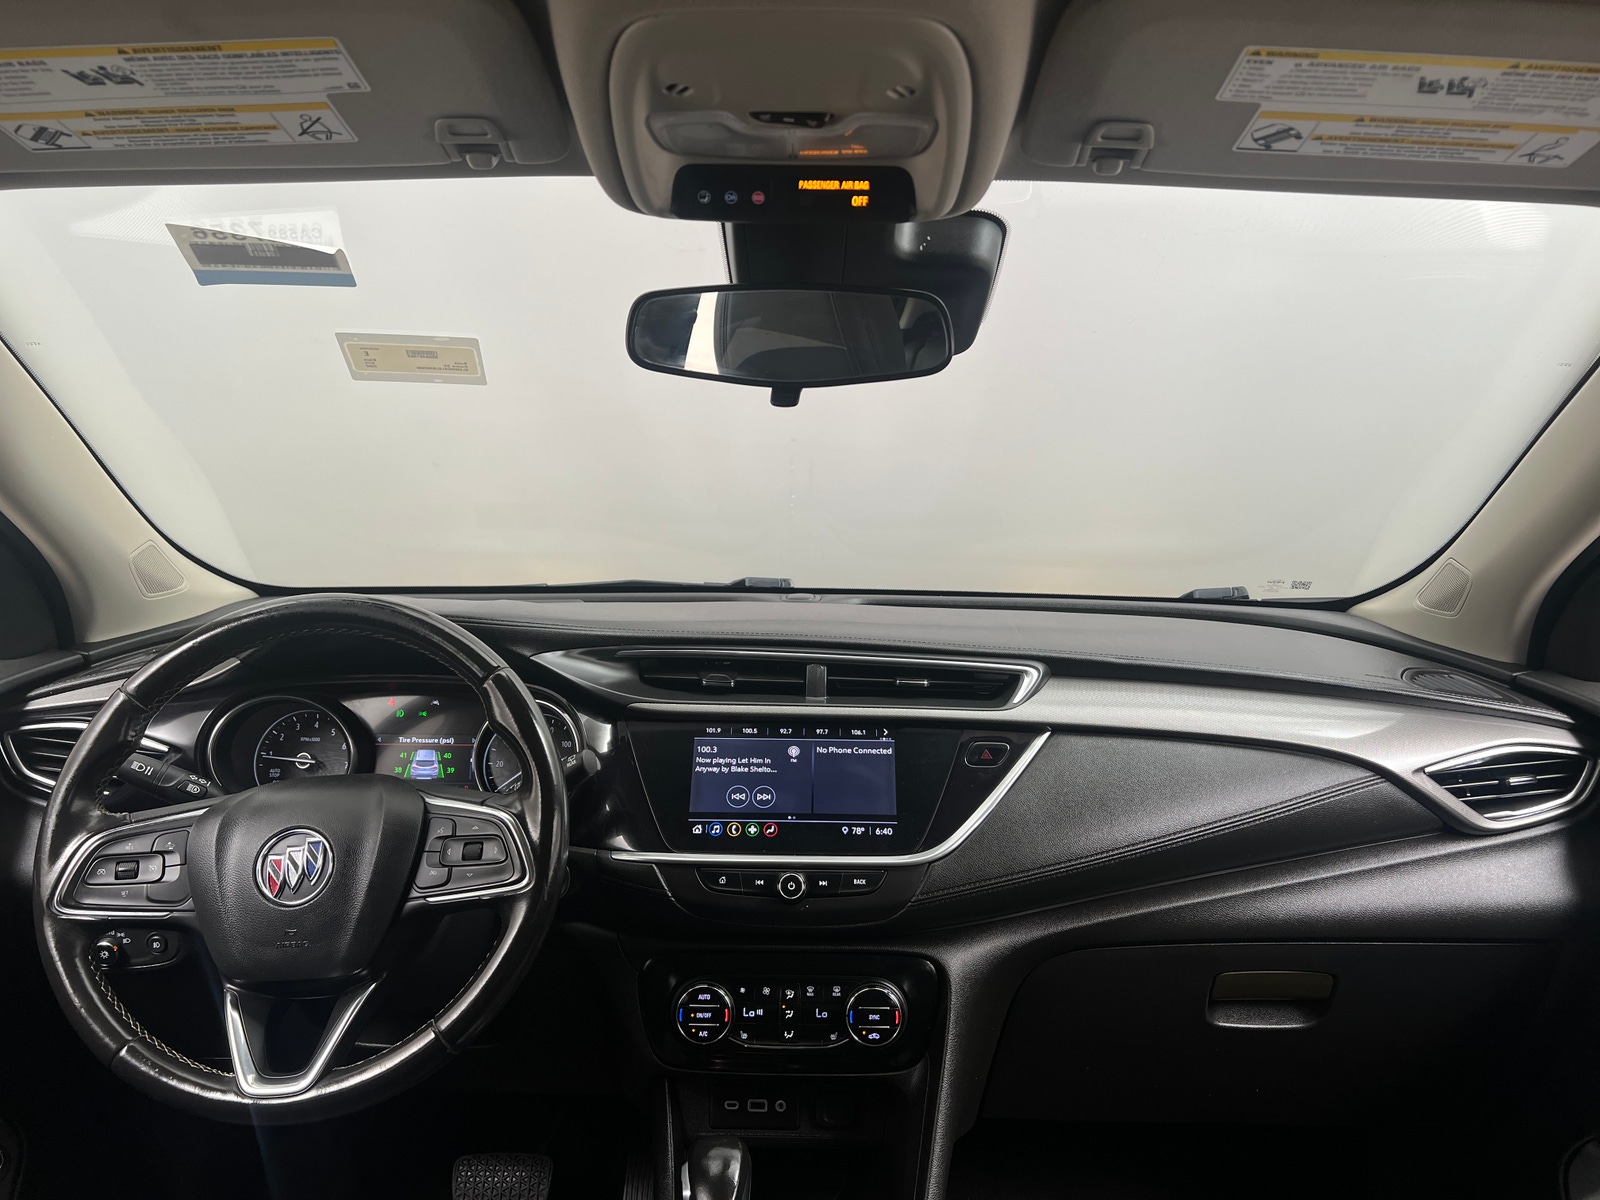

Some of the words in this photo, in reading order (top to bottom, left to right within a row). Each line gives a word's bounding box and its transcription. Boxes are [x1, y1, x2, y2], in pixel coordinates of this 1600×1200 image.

[798, 180, 840, 190] PASSENGER
[840, 180, 854, 190] AIR
[854, 180, 870, 190] BAG
[851, 195, 869, 207] OFF
[440, 737, 455, 745] (psi)
[561, 740, 572, 748] 100
[853, 747, 892, 755] Connected
[344, 761, 348, 769] 7
[495, 760, 504, 768] 20
[712, 757, 737, 766] playing
[394, 766, 403, 774] 38
[446, 766, 455, 774] 39
[695, 766, 720, 774] Anyway
[721, 766, 729, 774] by
[851, 826, 865, 835] 78°
[875, 827, 893, 836] 6:40
[697, 993, 711, 1001] AUTO
[695, 1011, 712, 1019] ON/OFF
[743, 1007, 755, 1017] Lo
[815, 1008, 828, 1018] Lo
[698, 1030, 709, 1038] A/C
